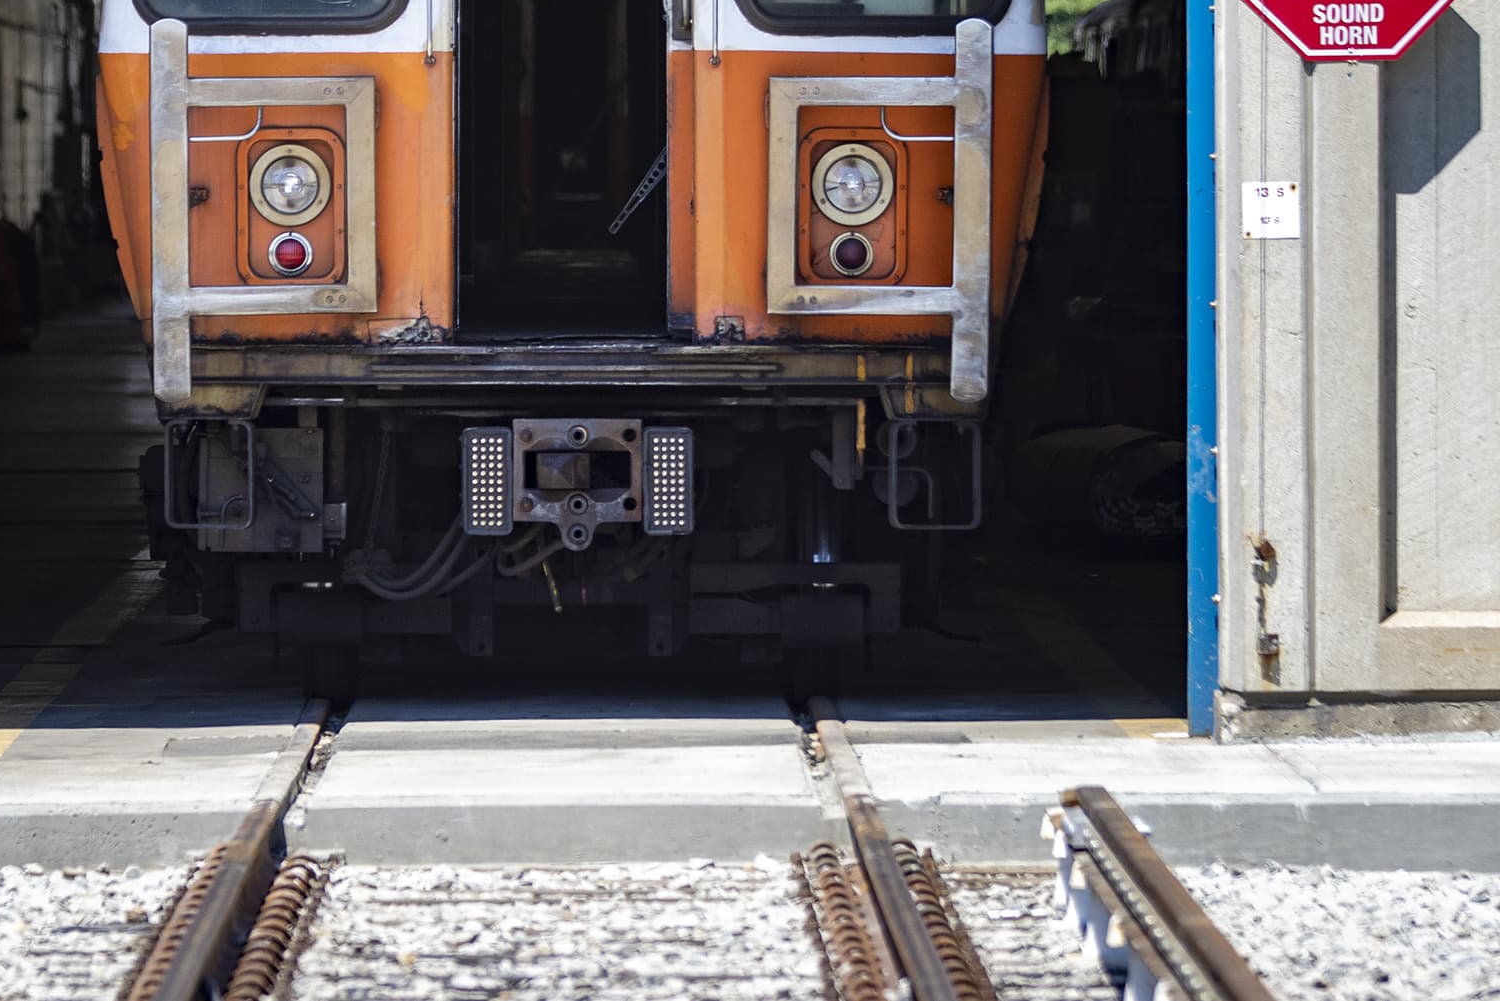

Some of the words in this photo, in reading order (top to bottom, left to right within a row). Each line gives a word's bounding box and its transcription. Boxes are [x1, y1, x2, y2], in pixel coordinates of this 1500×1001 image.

[1312, 3, 1385, 24] SOUND
[1319, 25, 1378, 45] HORN
[1256, 187, 1269, 198] 13
